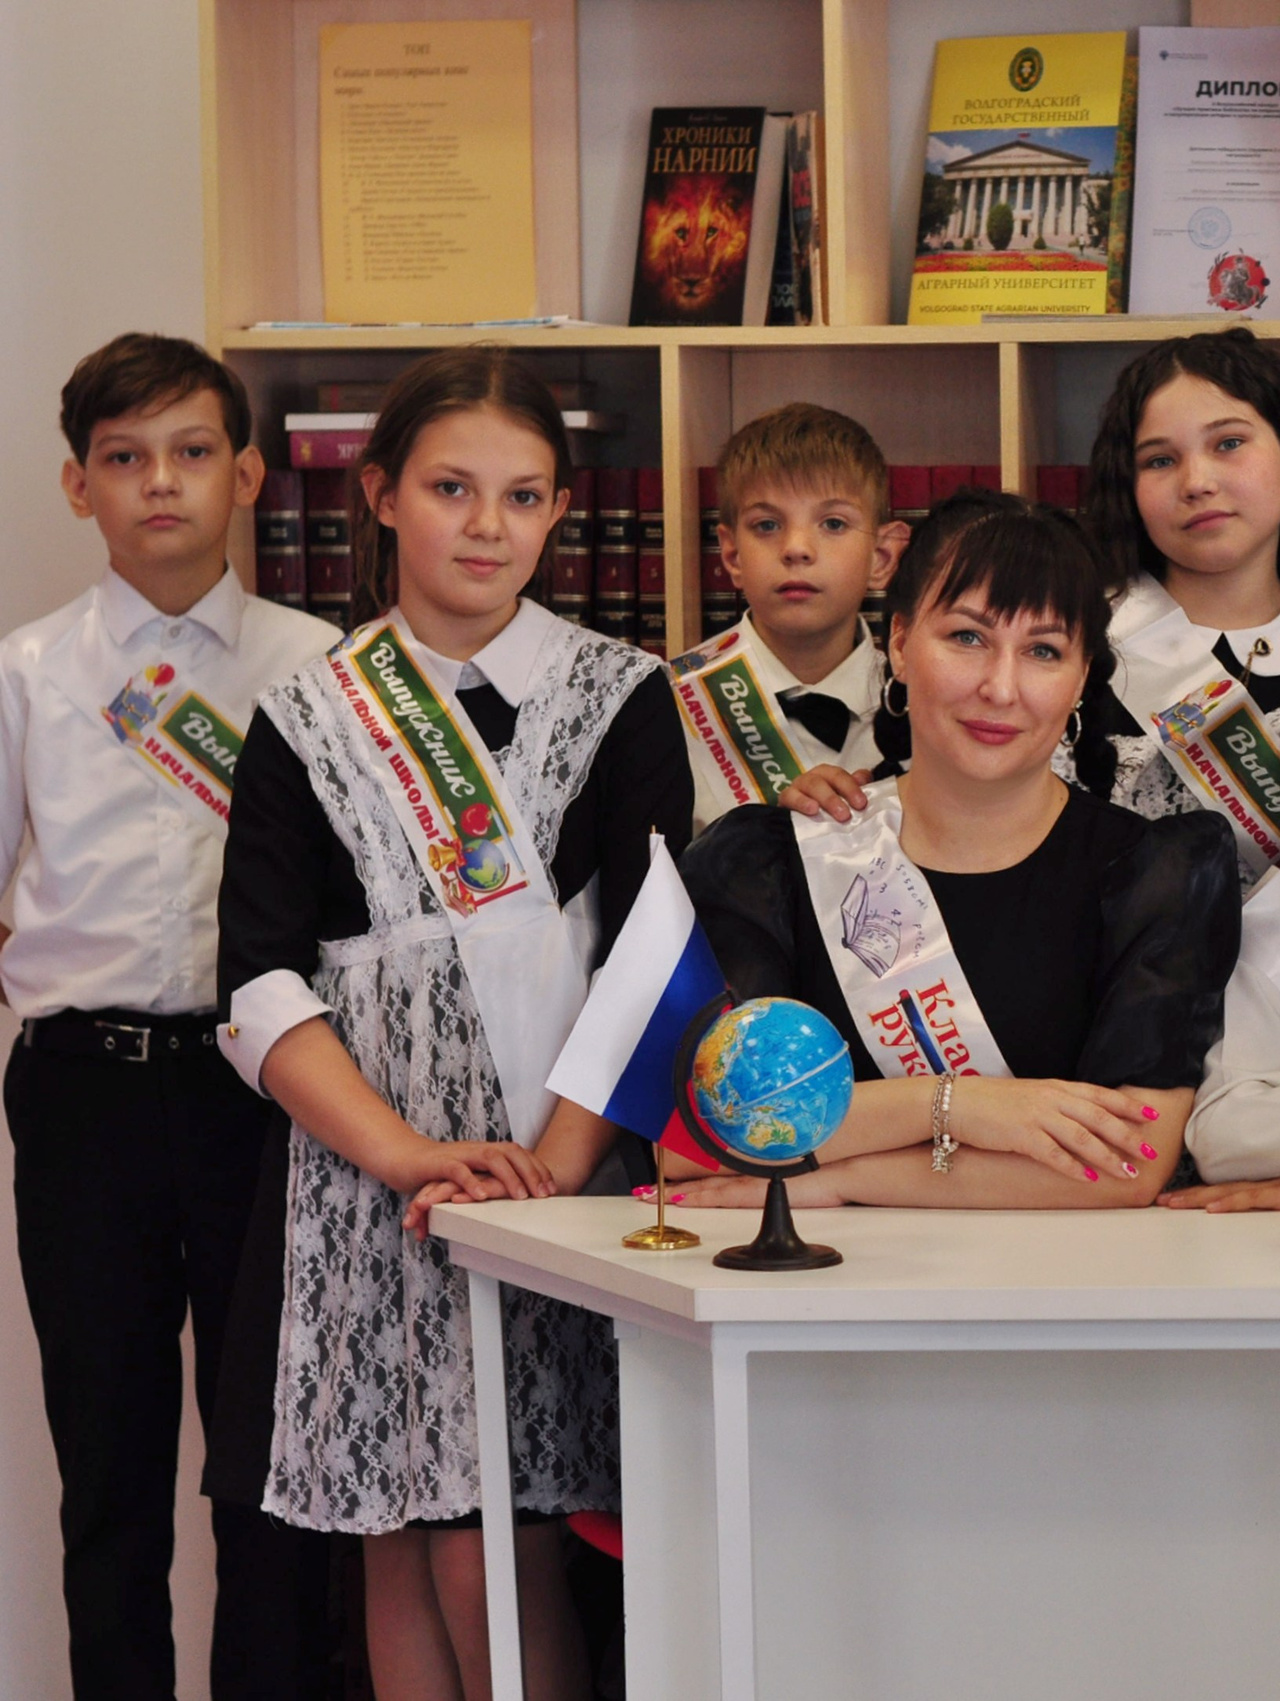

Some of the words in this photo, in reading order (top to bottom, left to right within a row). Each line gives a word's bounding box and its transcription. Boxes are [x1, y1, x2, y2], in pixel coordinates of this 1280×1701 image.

[952, 110, 1090, 126] ГОСУДАРСТВЕННЫЙ
[964, 94, 1081, 110] ВОЛГОГРАДСКИЙ
[652, 146, 757, 174] НАРНИИ
[662, 126, 753, 145] ХРОНИКИ
[917, 276, 990, 291] АГРАРНЫЙ
[993, 277, 1097, 290] УНИВЕРСИТЕТ
[920, 304, 969, 313] VOLGOGRAD
[970, 304, 994, 313] STATE
[996, 304, 1038, 313] AGRARIAN
[1040, 304, 1091, 313] UNIVERSITY
[713, 567, 722, 577] 6
[370, 641, 476, 798] Выпускник
[678, 683, 750, 805] НАЧАЛЬНОЙ
[720, 673, 793, 794] Выпуск
[329, 660, 393, 752] НАЧАЛЬНОЙ
[388, 753, 440, 841] ШКОЛЫ
[144, 736, 231, 823] НАЧАЛЬН
[1185, 742, 1280, 860] НАЧАЛЬНОЙ
[867, 1000, 928, 1077] рук
